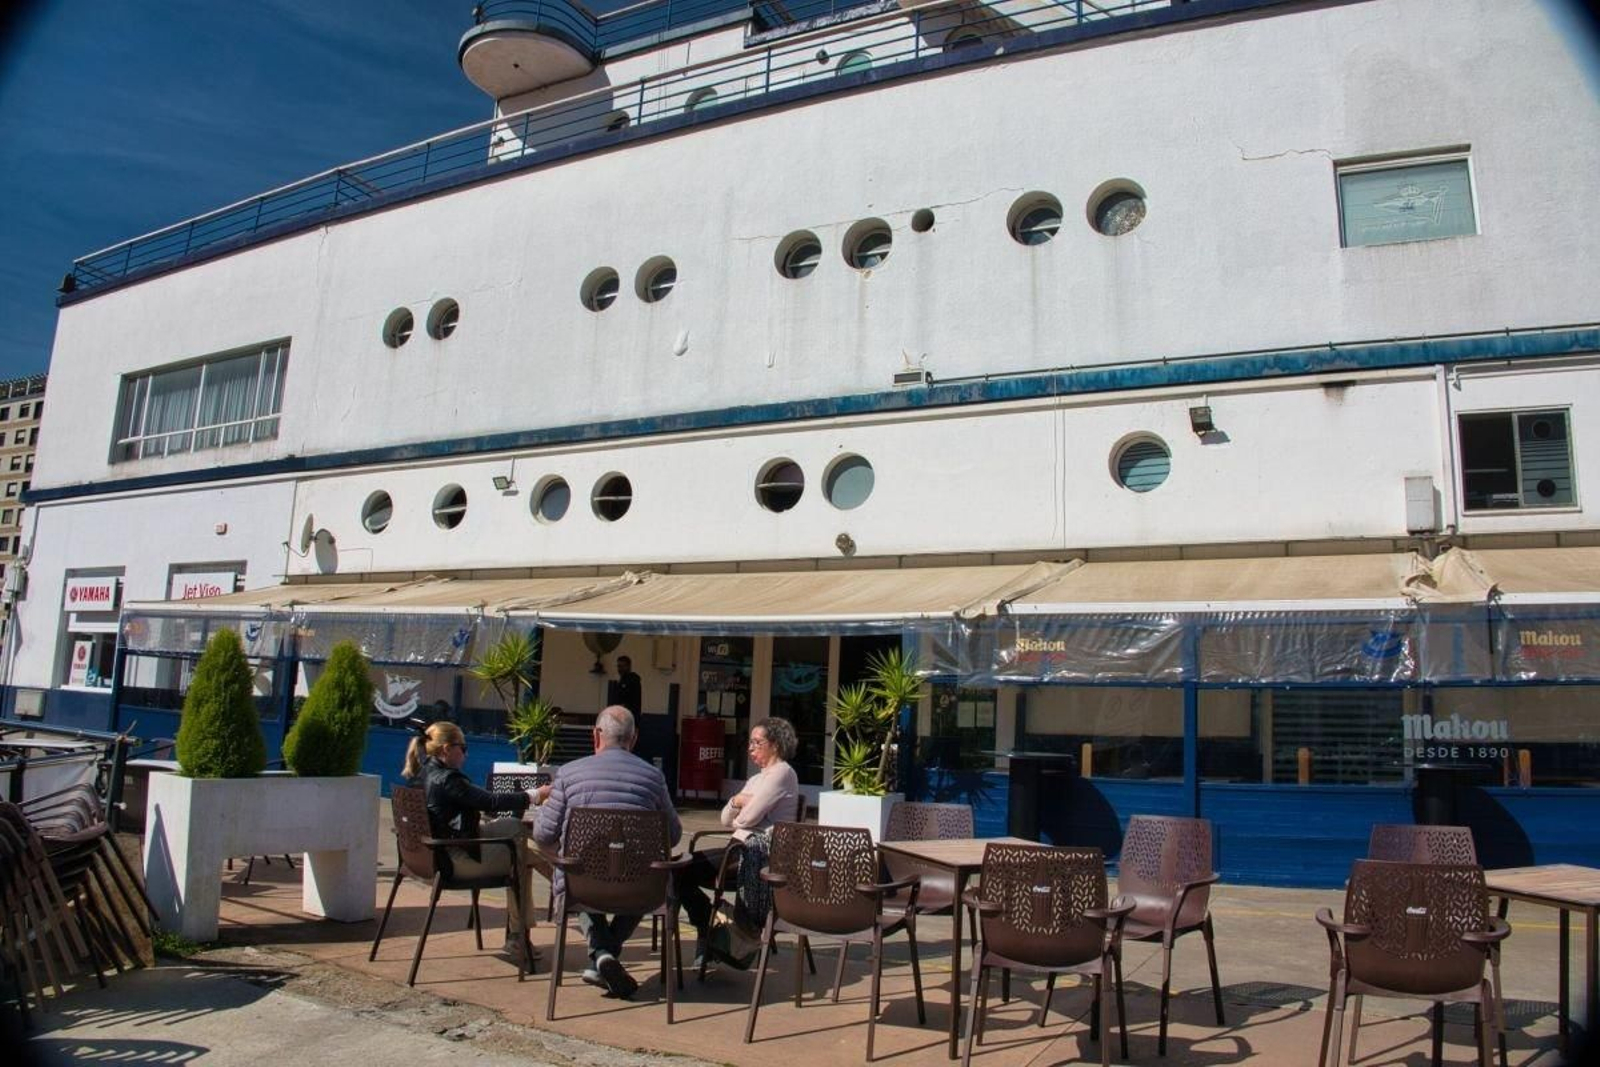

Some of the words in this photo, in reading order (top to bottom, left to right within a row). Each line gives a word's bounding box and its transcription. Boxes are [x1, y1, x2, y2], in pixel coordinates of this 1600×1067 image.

[79, 586, 110, 602] YAMAHA
[183, 583, 197, 600] Jet
[1520, 630, 1581, 646] Mahou
[1401, 713, 1508, 740] Mahou
[1403, 747, 1460, 759] DESDE
[1468, 747, 1509, 759] 1890
